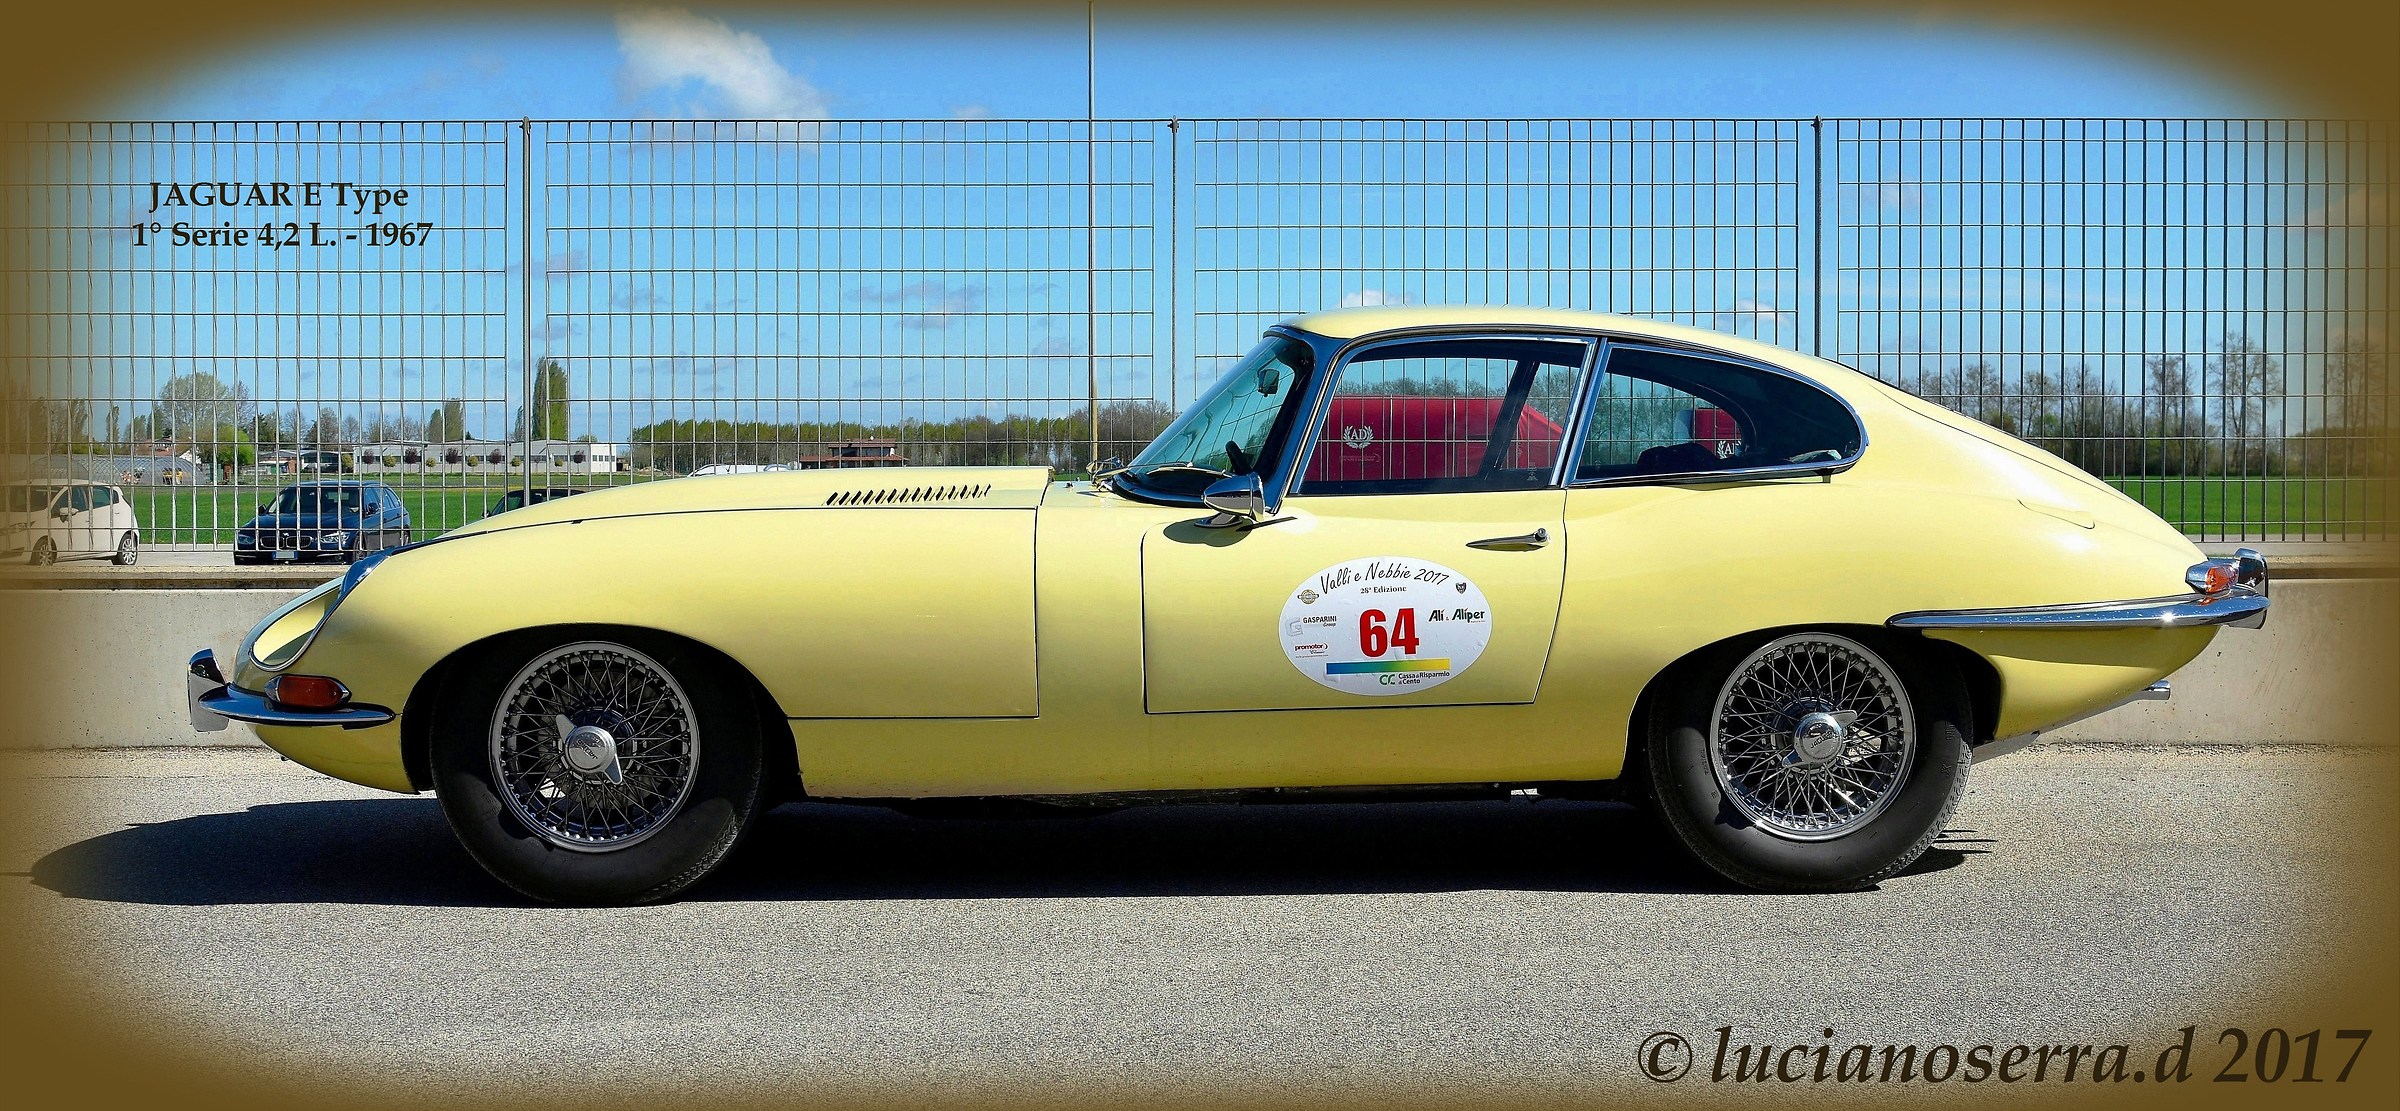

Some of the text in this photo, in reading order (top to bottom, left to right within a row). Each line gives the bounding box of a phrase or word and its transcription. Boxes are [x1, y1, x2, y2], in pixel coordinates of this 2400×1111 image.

[1321, 561, 1450, 594] Valli e Nebbie 2017
[1373, 585, 1407, 594] Edizione
[1302, 615, 1337, 624] GASPARINI
[1359, 607, 1420, 658] 64
[1398, 672, 1416, 680] Cassa
[1419, 670, 1451, 680] Risparmio
